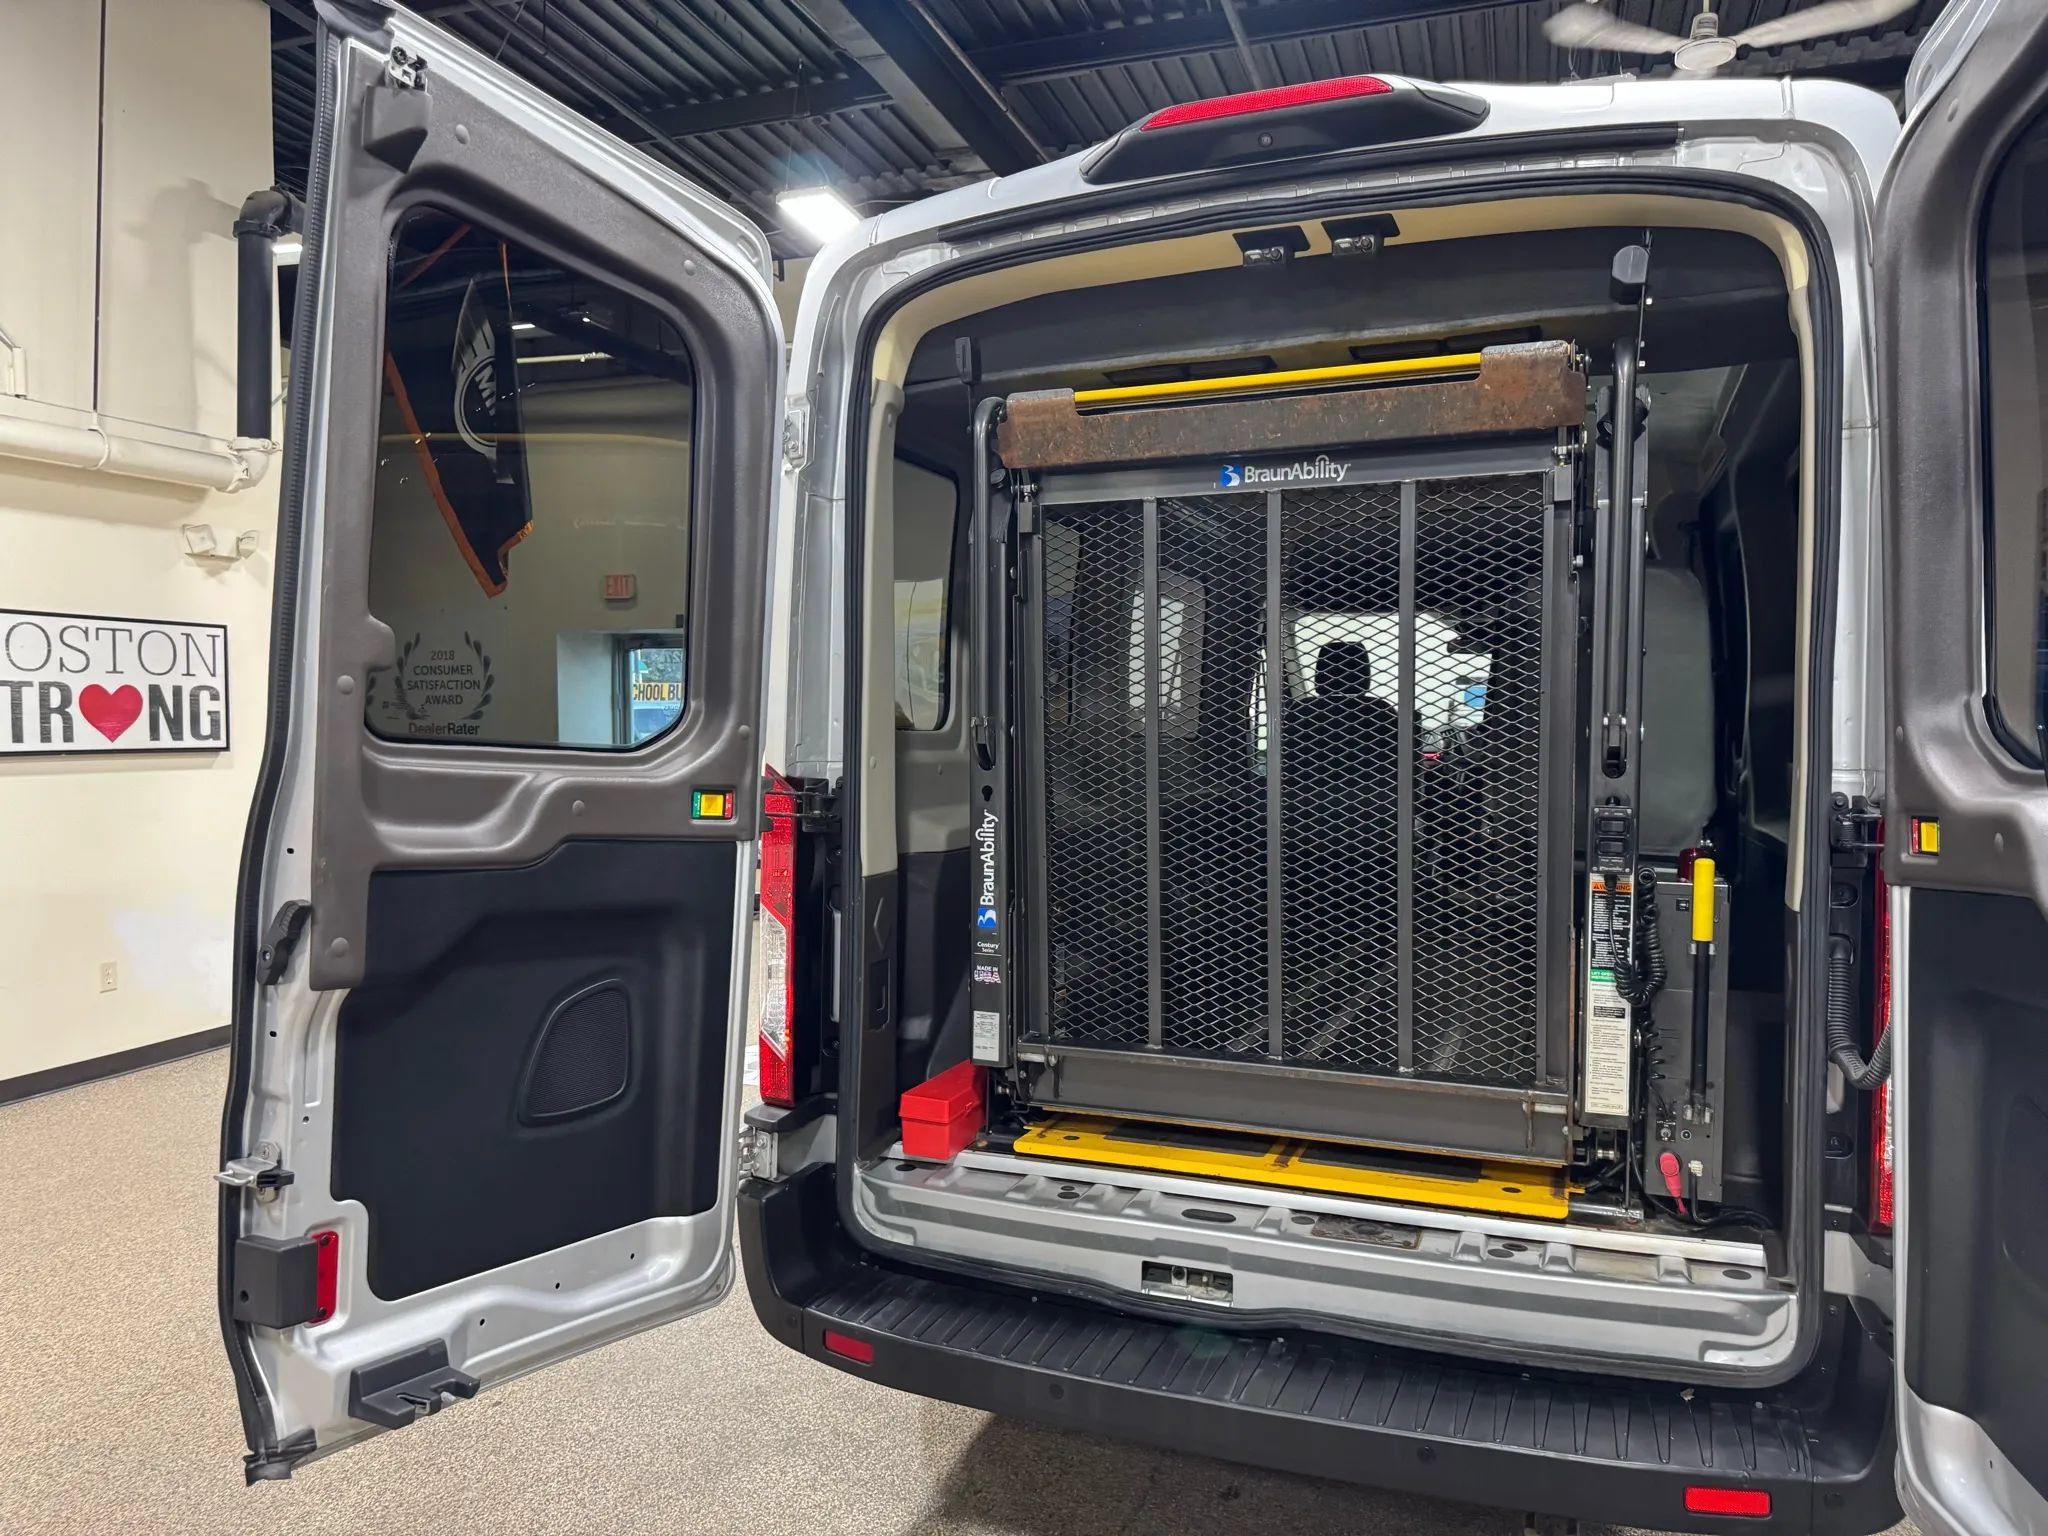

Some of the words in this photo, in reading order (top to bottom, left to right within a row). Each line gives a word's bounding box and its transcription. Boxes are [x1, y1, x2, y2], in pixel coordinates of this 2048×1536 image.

[1244, 454, 1348, 482] BraunAbility
[606, 575, 630, 596] EXIT
[4, 621, 221, 677] OSTON
[431, 650, 455, 660] 2018
[413, 664, 473, 676] CONSUMER
[407, 679, 480, 691] SATISFACTION
[425, 694, 464, 705] AWARD
[408, 722, 480, 736] DealerRater
[975, 810, 998, 906] BraunAbility
[977, 941, 999, 950] Century
